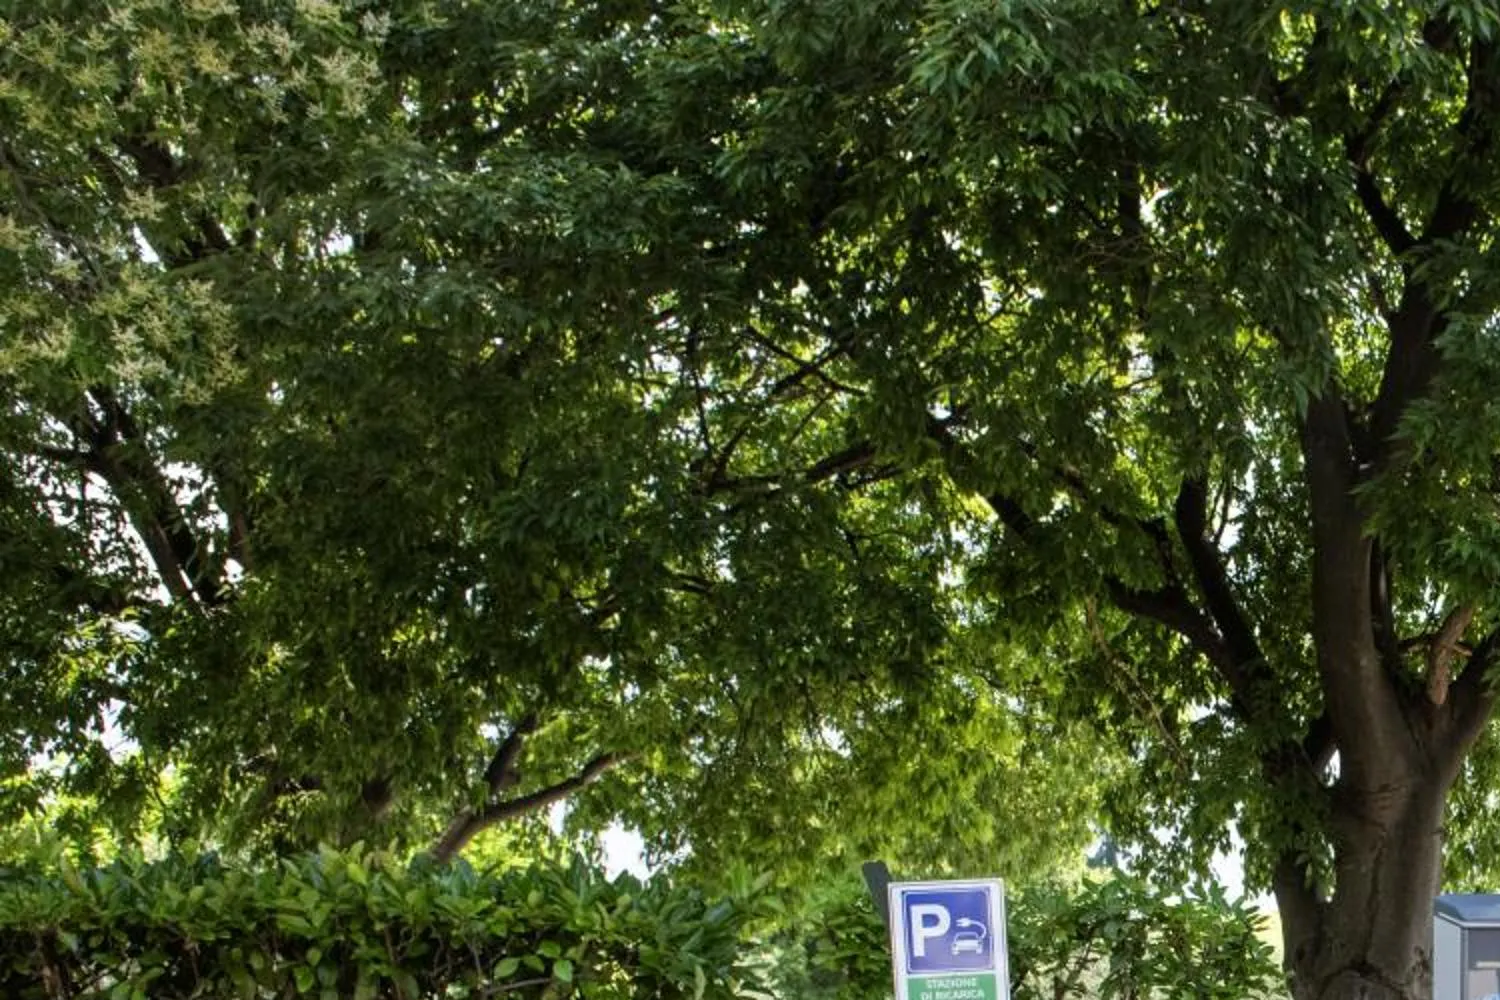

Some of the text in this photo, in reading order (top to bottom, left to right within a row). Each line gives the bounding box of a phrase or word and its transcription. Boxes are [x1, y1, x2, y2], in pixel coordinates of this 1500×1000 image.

[910, 904, 951, 957] P
[926, 978, 977, 989] STAZIONE
[920, 989, 985, 1000] DI RICARICA
